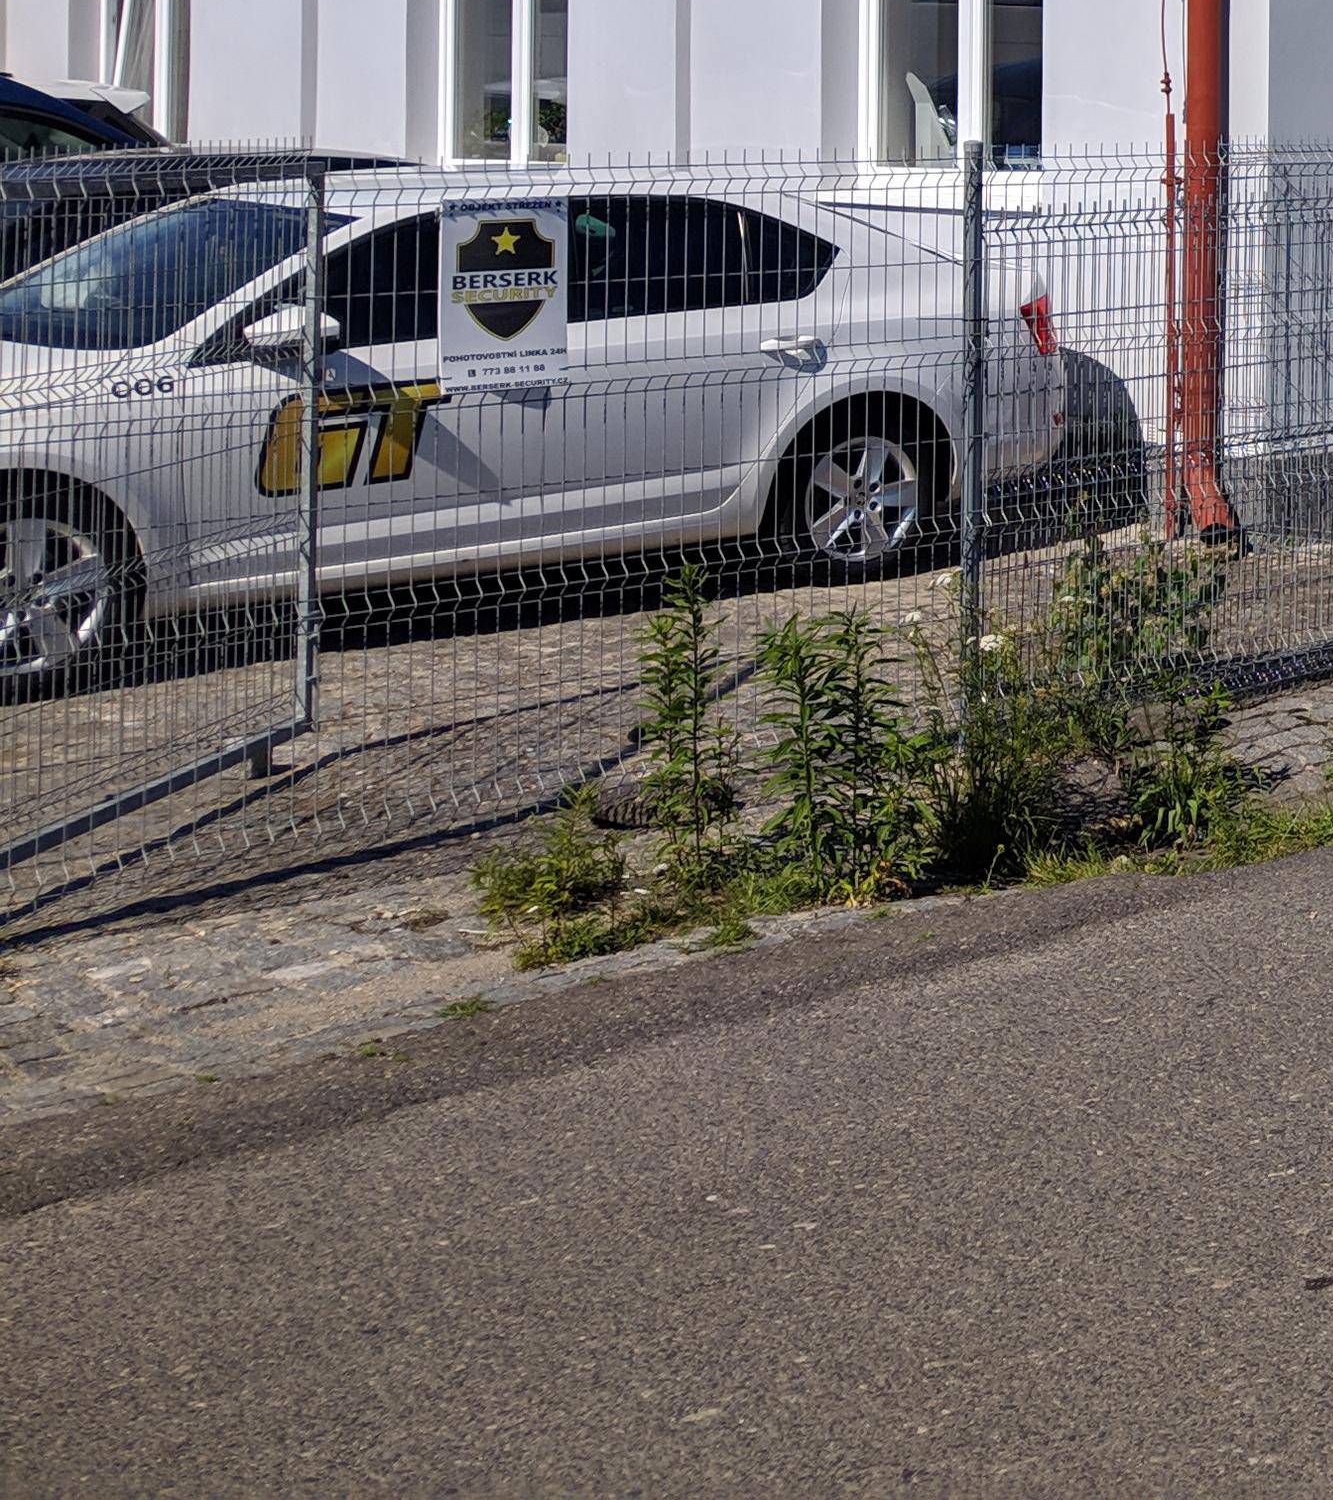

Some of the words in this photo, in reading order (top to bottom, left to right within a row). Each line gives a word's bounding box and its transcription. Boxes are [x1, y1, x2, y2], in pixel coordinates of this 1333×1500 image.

[460, 202, 502, 212] OBJEKT
[452, 270, 558, 290] BERSERK
[451, 286, 558, 304] SECURITY
[442, 350, 517, 363] POHOTOVOSTNÍ
[519, 348, 548, 358] LINKA
[519, 364, 530, 374] 11
